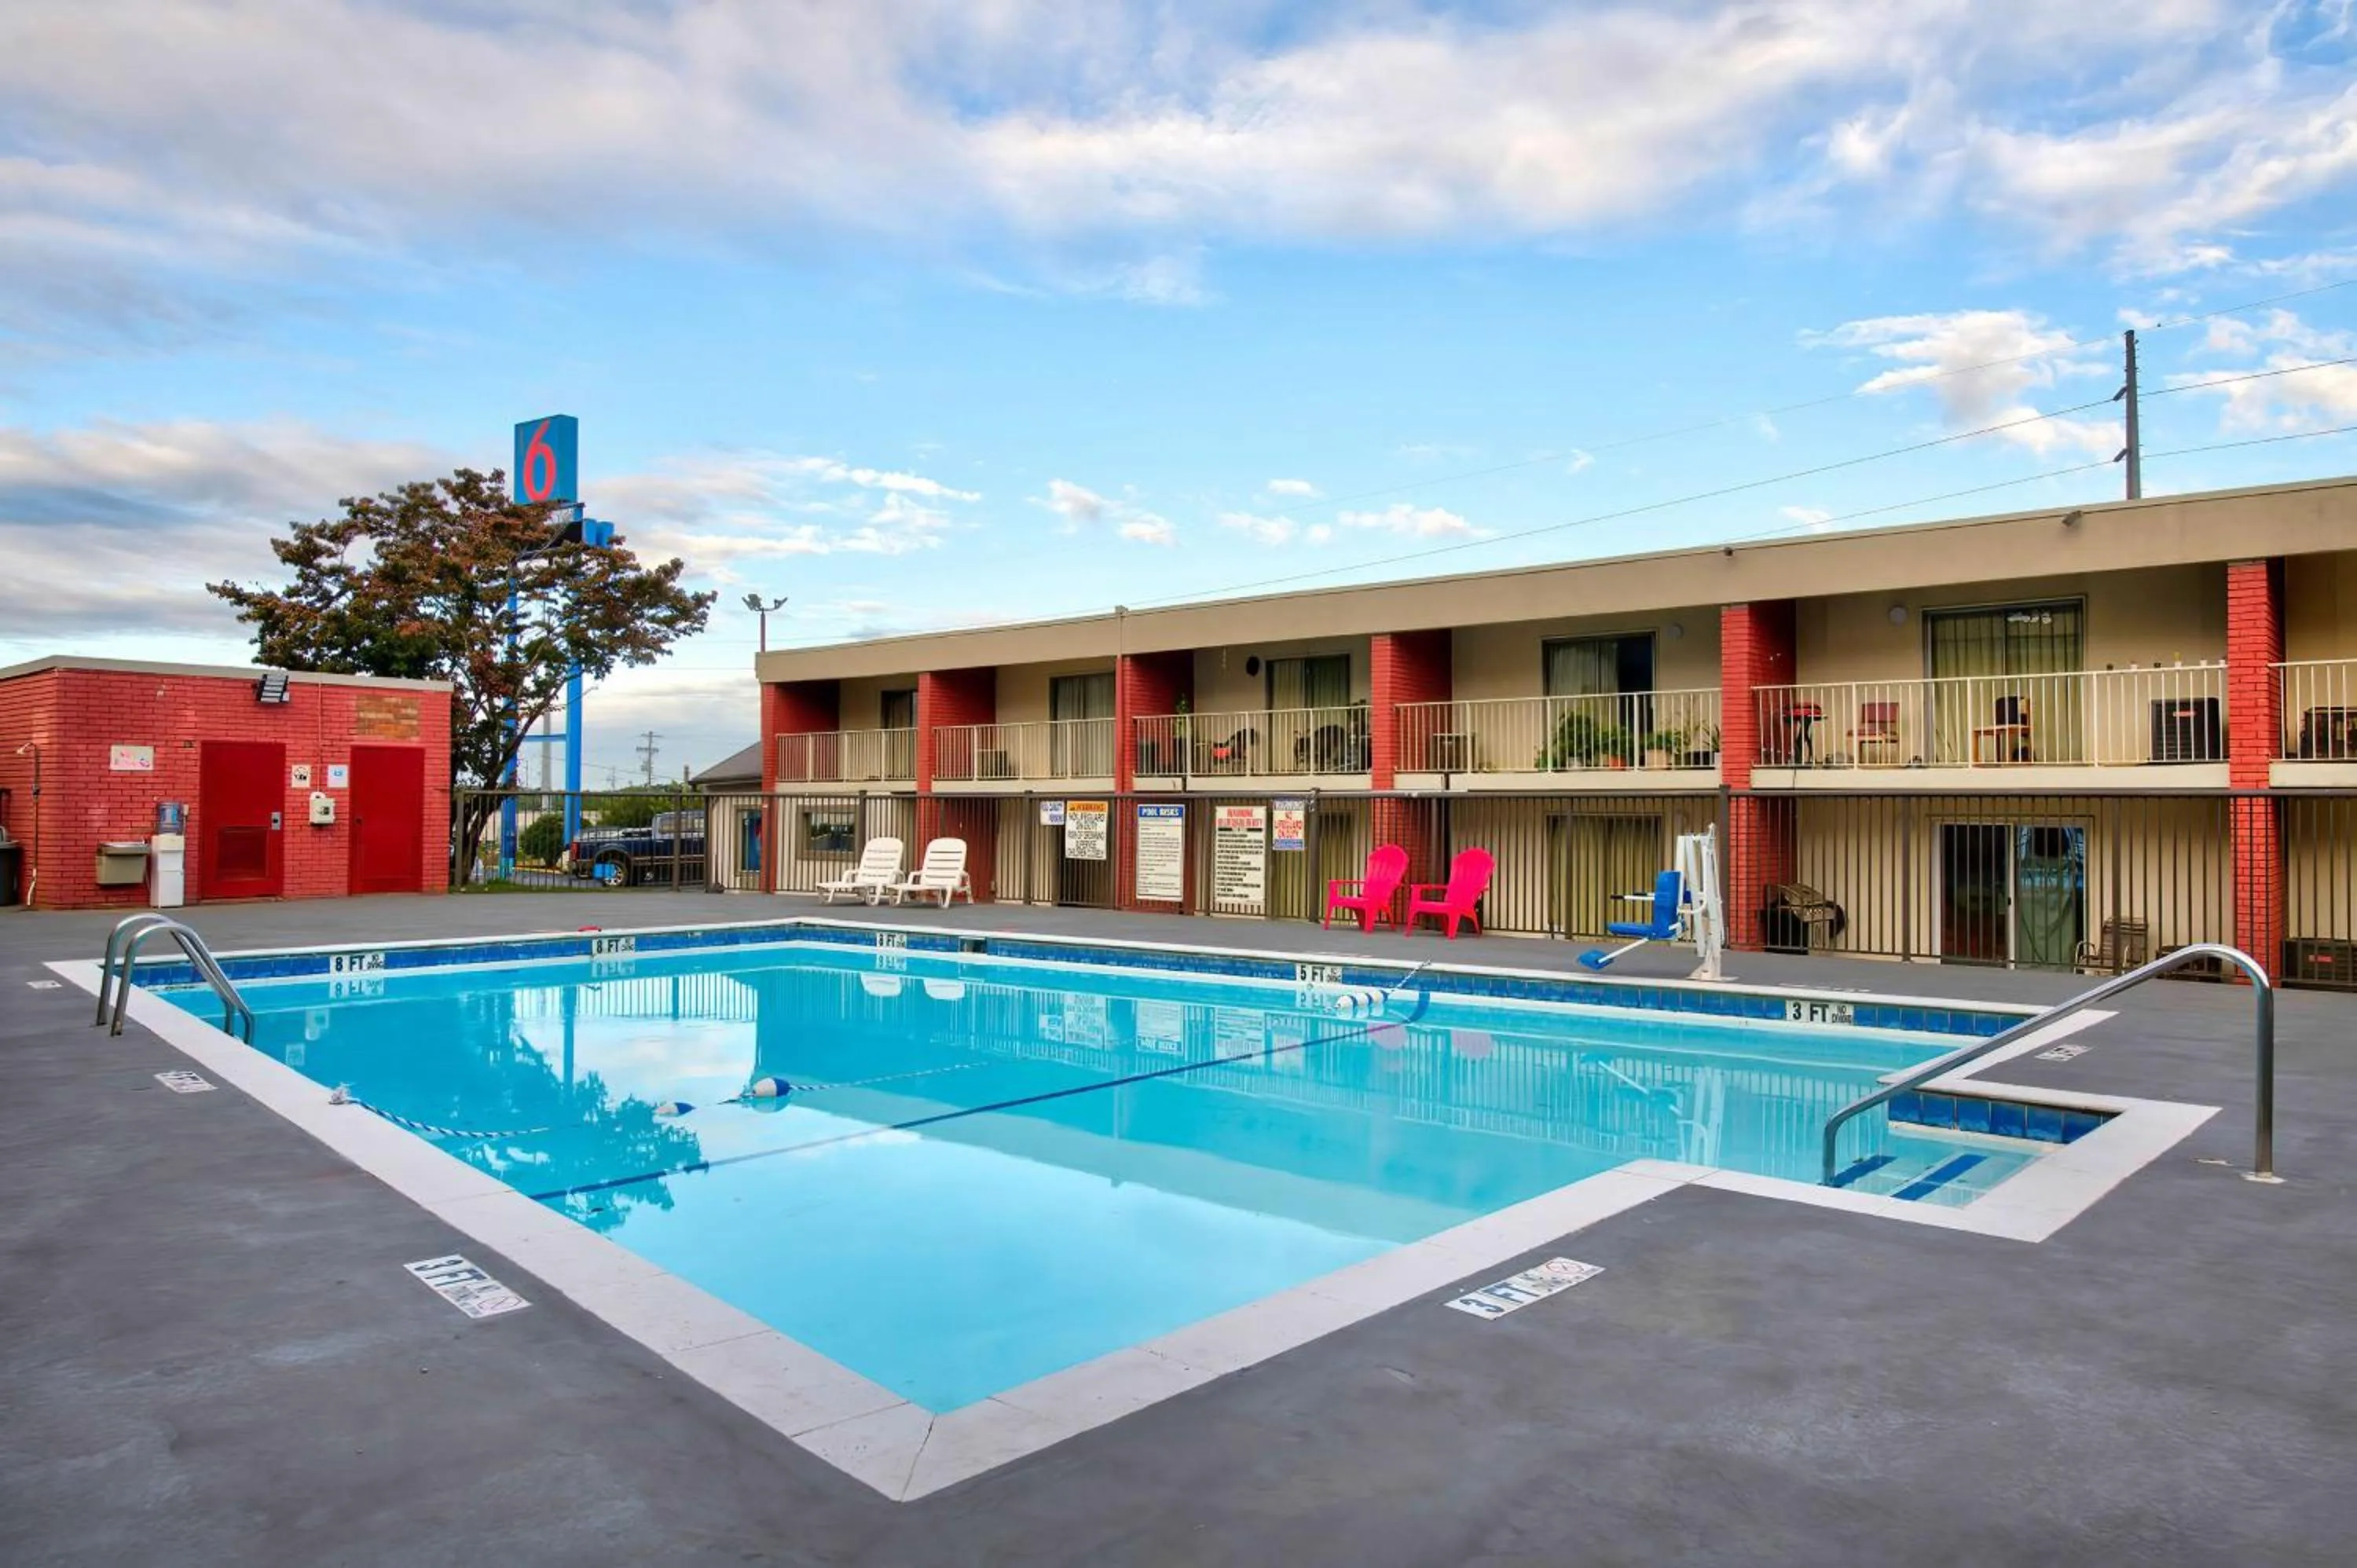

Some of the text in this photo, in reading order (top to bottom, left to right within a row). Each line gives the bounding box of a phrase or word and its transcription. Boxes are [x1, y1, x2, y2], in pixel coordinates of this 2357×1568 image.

[523, 419, 557, 503] 6
[1142, 808, 1158, 816] POOL
[597, 940, 603, 954] 8
[607, 940, 620, 953] FT
[335, 954, 365, 972] 8 FT
[1300, 964, 1325, 982] 5 FT
[1793, 1002, 1829, 1022] 3 FT
[424, 1269, 487, 1287] FT
[1459, 1299, 1505, 1313] 3
[1482, 1282, 1540, 1305] FT
